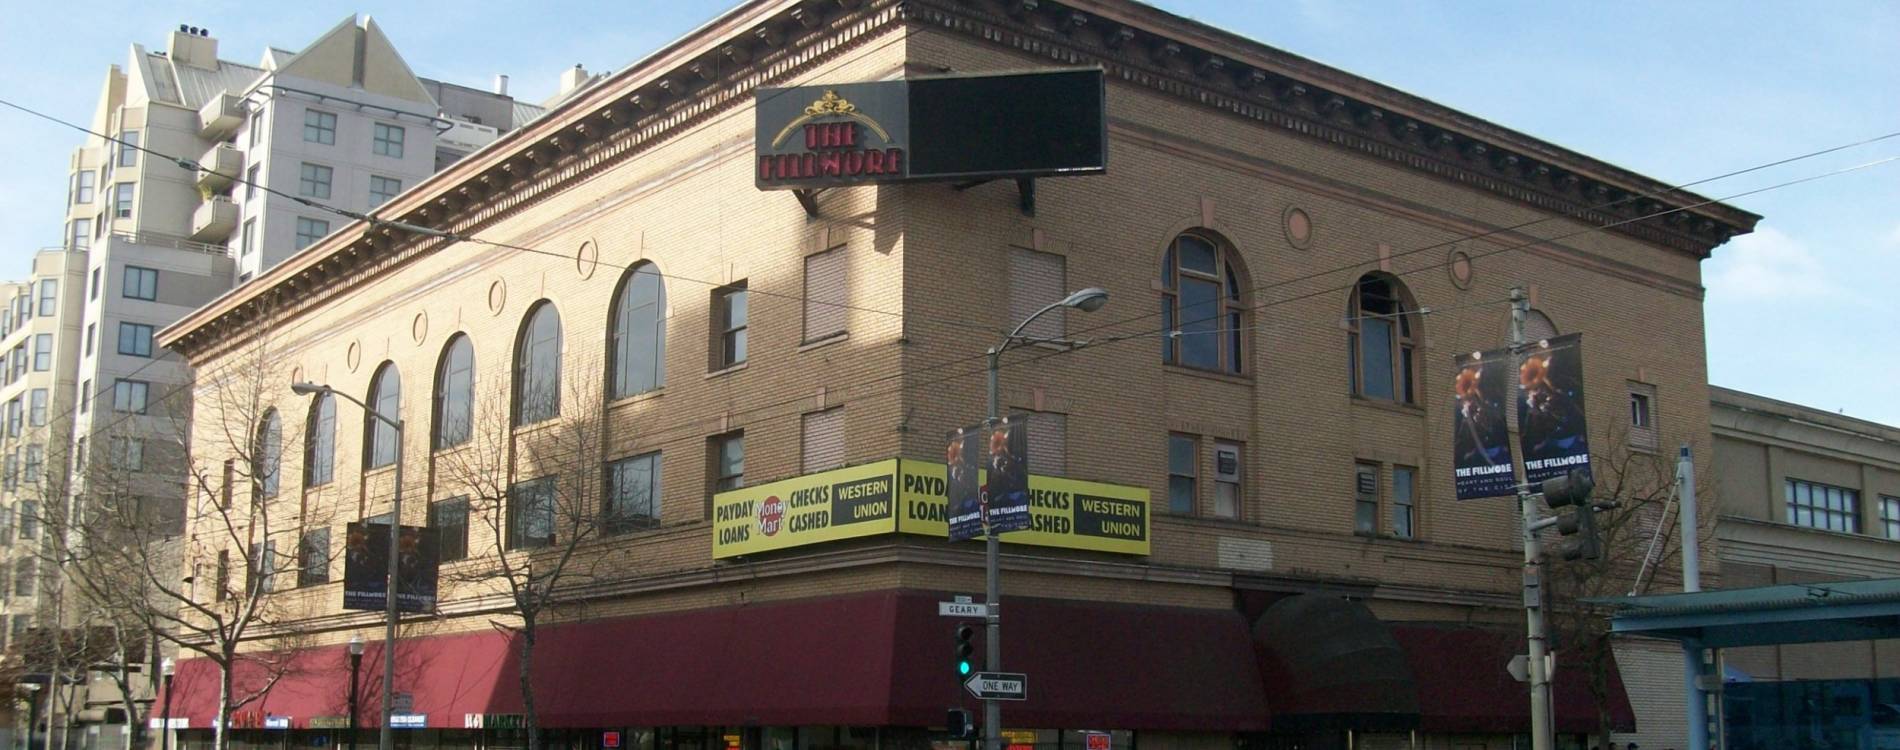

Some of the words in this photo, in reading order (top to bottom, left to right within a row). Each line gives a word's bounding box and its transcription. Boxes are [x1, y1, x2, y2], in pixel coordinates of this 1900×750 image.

[803, 121, 857, 149] THE
[759, 148, 902, 180] FILLMORE
[1456, 468, 1471, 477] THE
[1472, 463, 1512, 475] FILLMORE
[1525, 460, 1543, 470] THE
[1544, 454, 1589, 468] FILLMORE
[838, 480, 888, 500] WESTERN
[904, 474, 948, 496] PAYD
[790, 485, 829, 508] CHECKS
[1028, 488, 1069, 510] HECKS
[717, 499, 754, 522] PAYDAY
[756, 499, 789, 519] Money
[854, 500, 888, 518] UNION
[909, 500, 949, 522] LOAN
[958, 511, 980, 522] FILLMORE
[989, 508, 1000, 516] THE
[1001, 505, 1028, 515] FILLMORE
[1081, 499, 1140, 517] WESTERN
[758, 515, 784, 535] Mart
[789, 510, 829, 533] CASHED
[1030, 513, 1070, 534] ASHED
[1101, 520, 1140, 536] UNION
[719, 524, 750, 545] LOANS
[949, 605, 978, 614] GEARY
[983, 681, 999, 690] ONE
[1002, 681, 1018, 691] WAY
